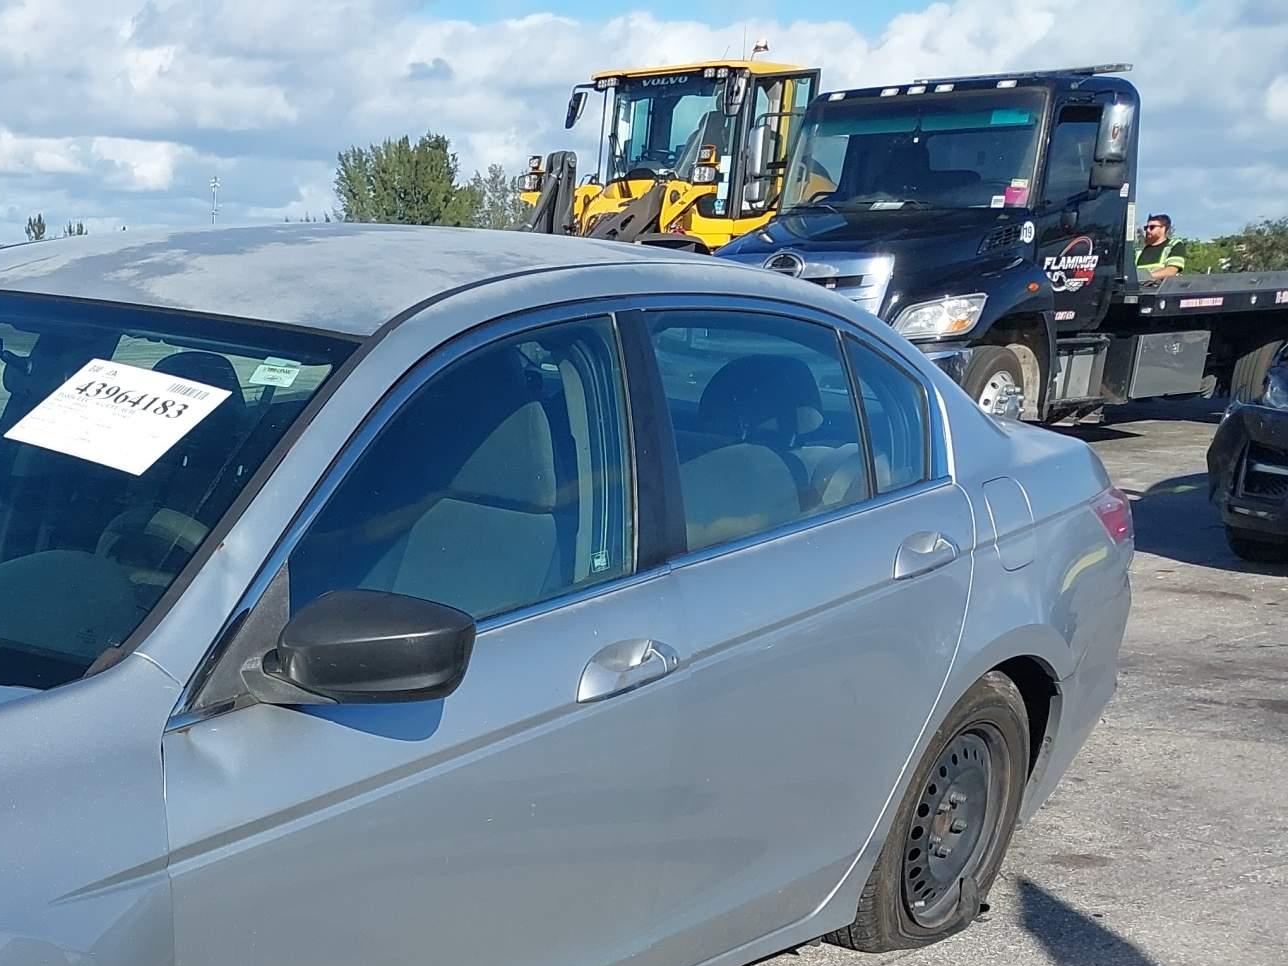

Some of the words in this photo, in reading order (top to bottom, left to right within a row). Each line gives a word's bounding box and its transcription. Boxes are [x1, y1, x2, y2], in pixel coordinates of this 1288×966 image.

[642, 75, 688, 87] VOLVO
[1043, 255, 1099, 270] FLAMINGO
[75, 380, 189, 419] 43964183
